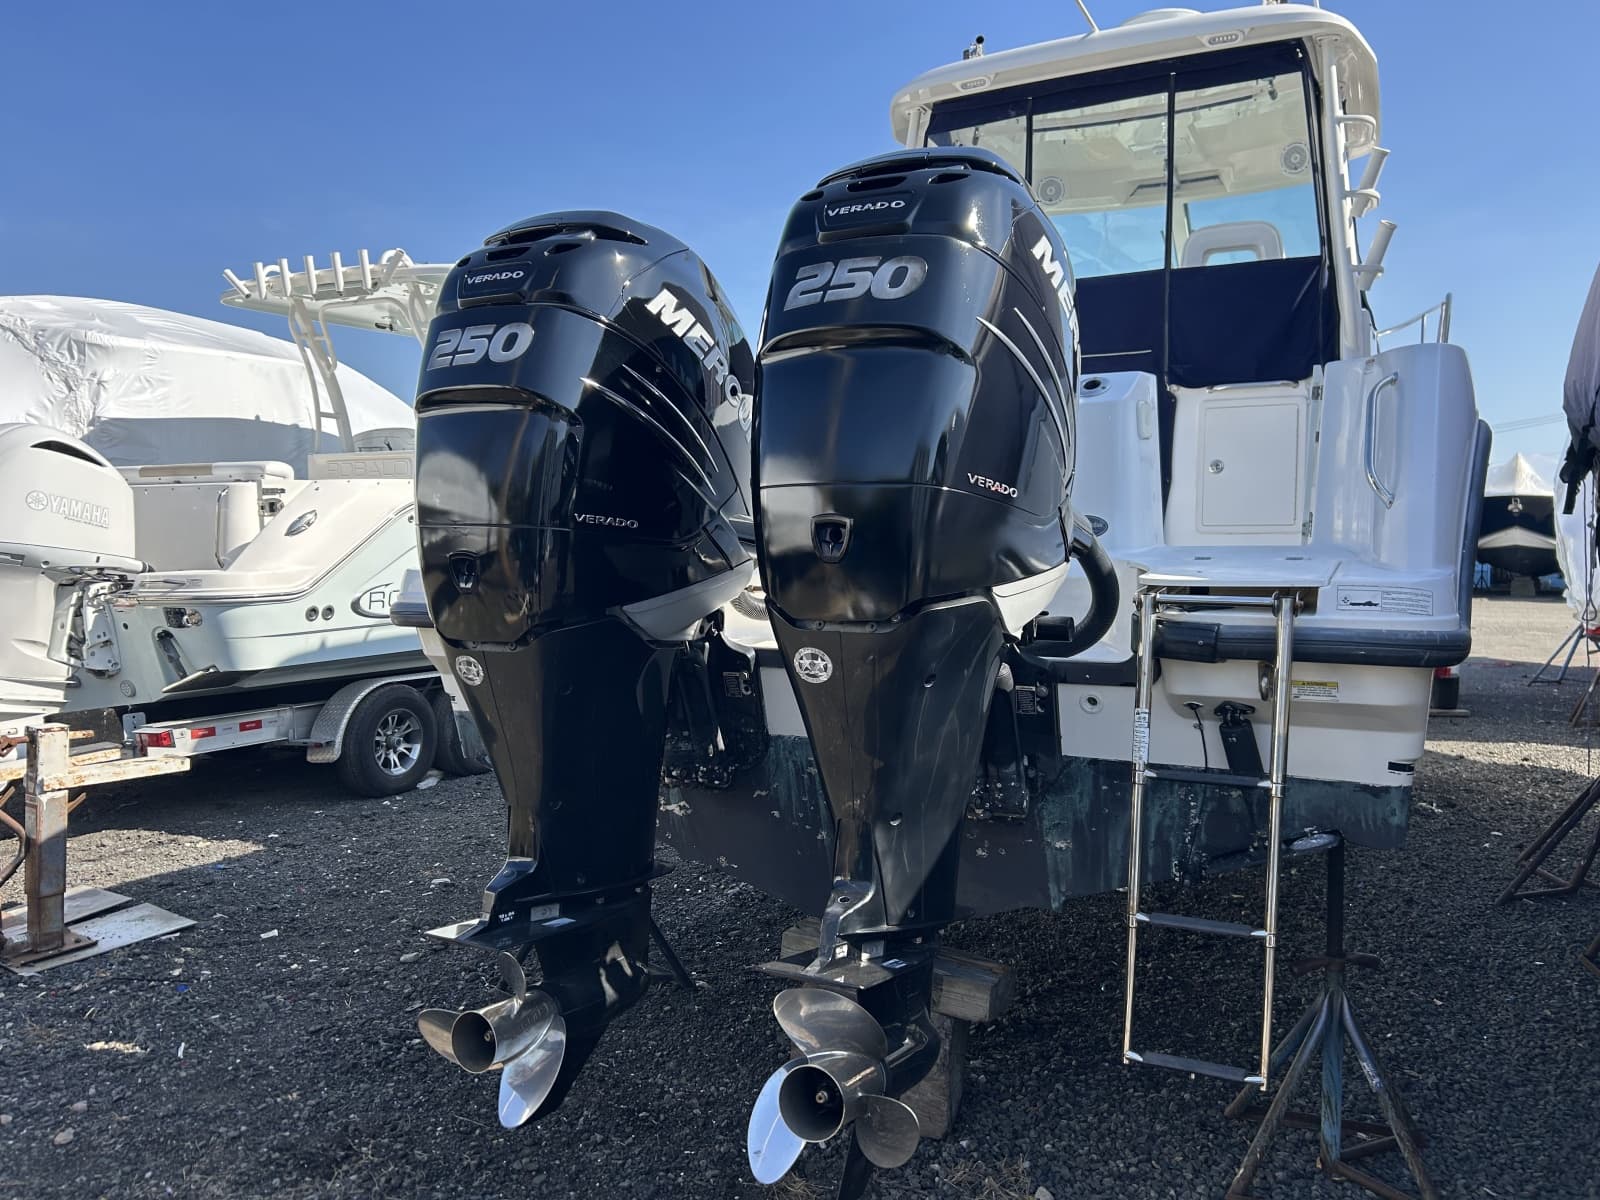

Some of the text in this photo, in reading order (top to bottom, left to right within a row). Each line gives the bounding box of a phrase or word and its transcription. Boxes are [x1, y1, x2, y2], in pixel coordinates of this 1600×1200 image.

[828, 201, 906, 217] VERADO
[467, 271, 524, 284] VERADO
[784, 256, 928, 312] 250
[426, 322, 534, 371] 250
[645, 289, 752, 444] MERCU
[967, 473, 1018, 497] VERADO
[49, 494, 109, 526] YAMAHA
[574, 513, 638, 528] VERADO
